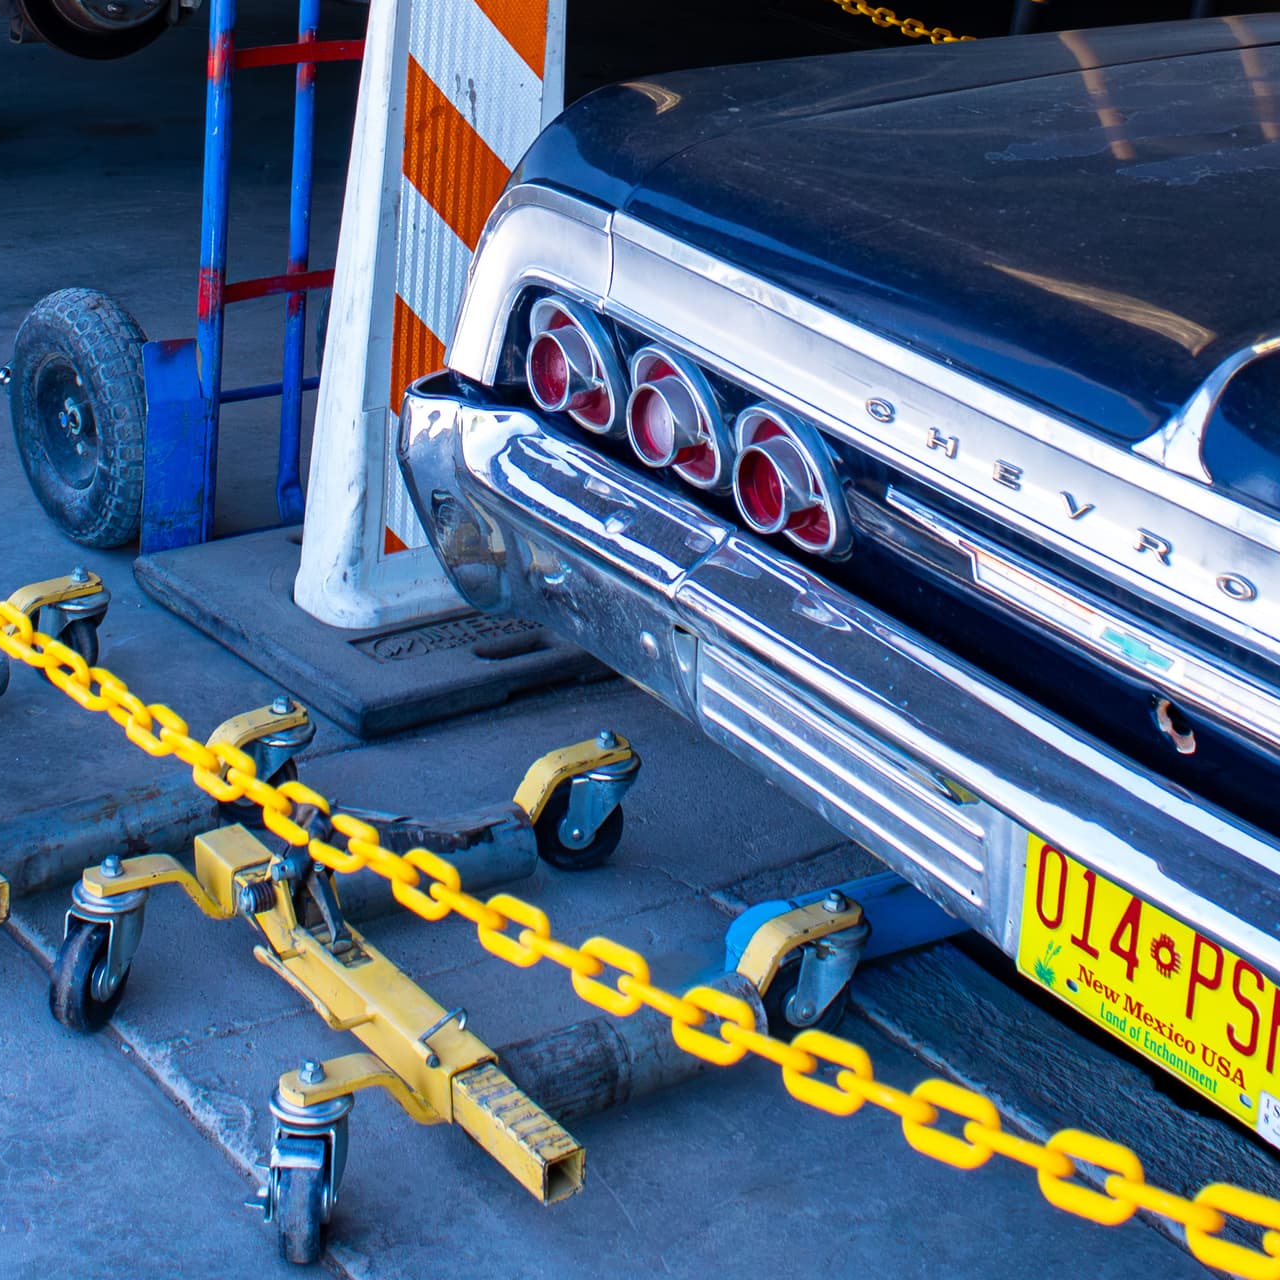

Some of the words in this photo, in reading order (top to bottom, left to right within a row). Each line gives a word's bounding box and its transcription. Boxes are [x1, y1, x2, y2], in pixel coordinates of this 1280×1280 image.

[1077, 963, 1121, 1005] New
[1122, 992, 1197, 1055] Mexico
[1200, 1042, 1248, 1091] USA
[1099, 1001, 1127, 1034] Land
[1129, 1024, 1142, 1042] of
[1143, 1030, 1219, 1095] Enchantment
